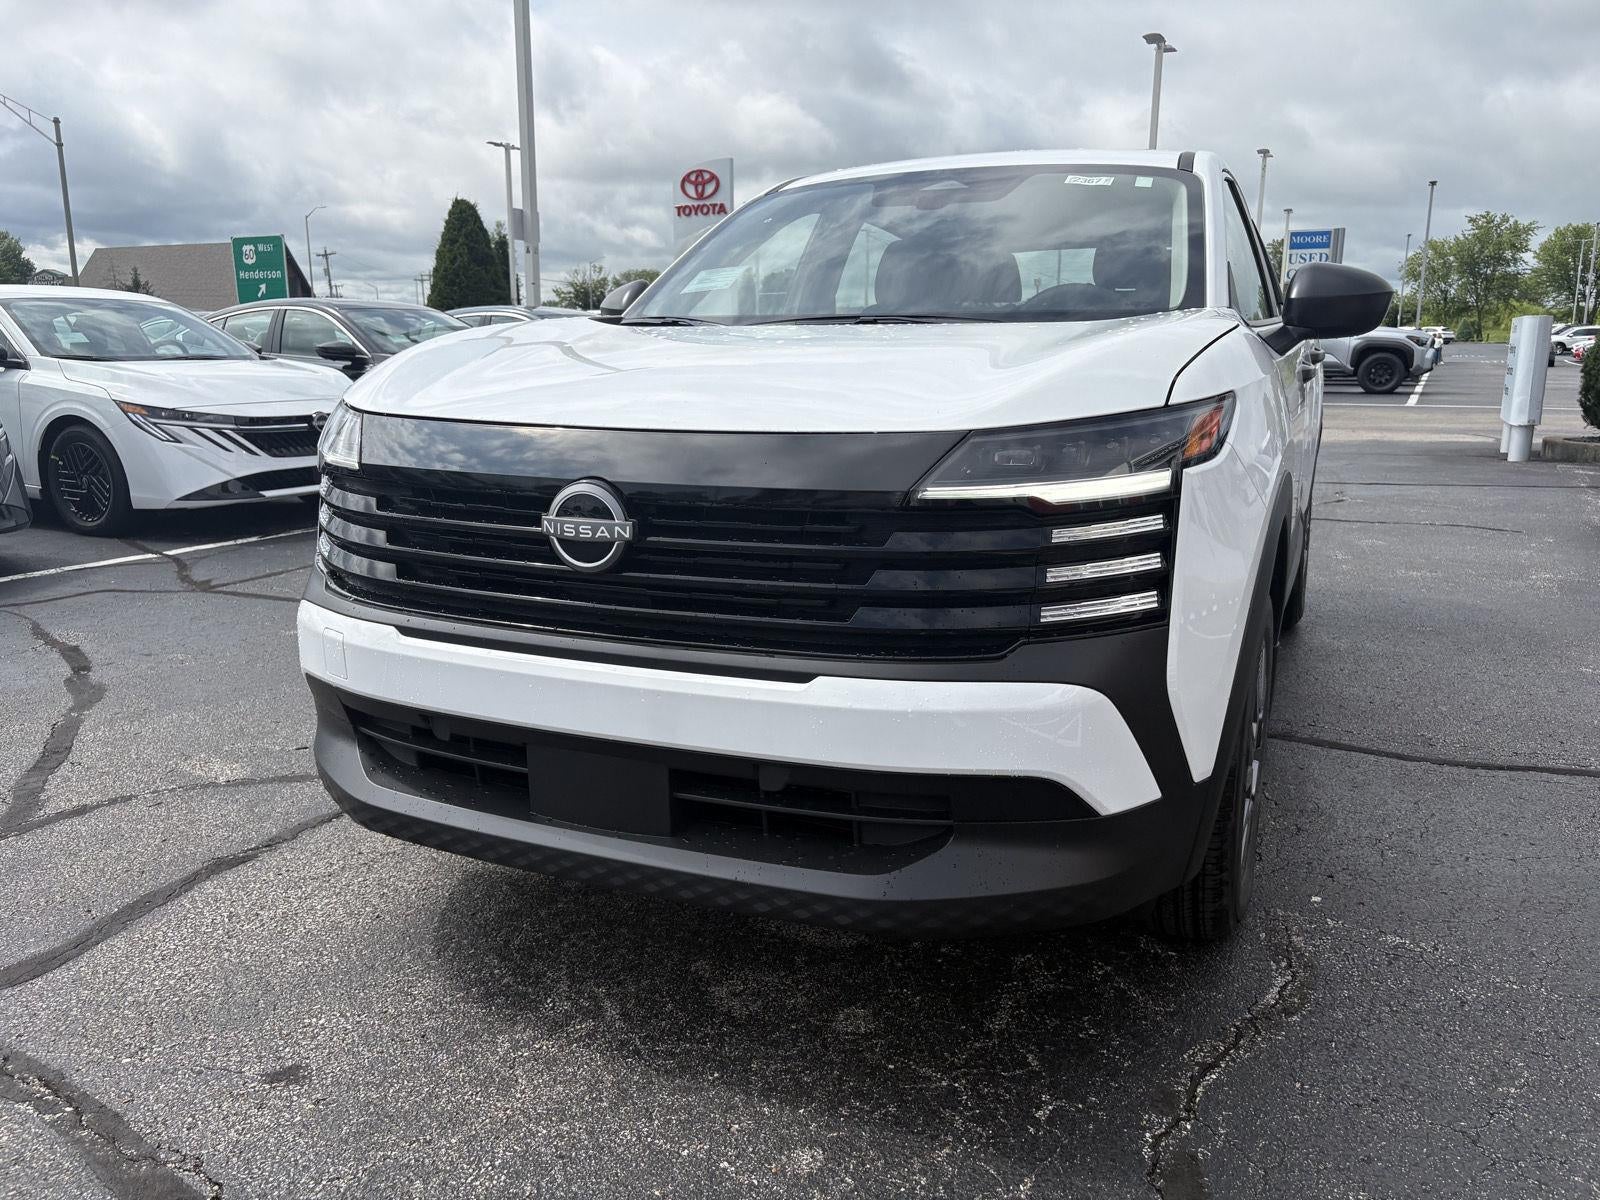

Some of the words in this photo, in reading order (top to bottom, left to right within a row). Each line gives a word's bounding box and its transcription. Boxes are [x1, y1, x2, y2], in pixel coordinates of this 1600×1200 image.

[674, 203, 728, 217] TOYOTA
[1291, 234, 1329, 244] MOORE
[244, 248, 255, 261] 60
[1288, 252, 1329, 265] USED
[239, 269, 282, 280] Henderson
[543, 520, 630, 538] NISSAN
